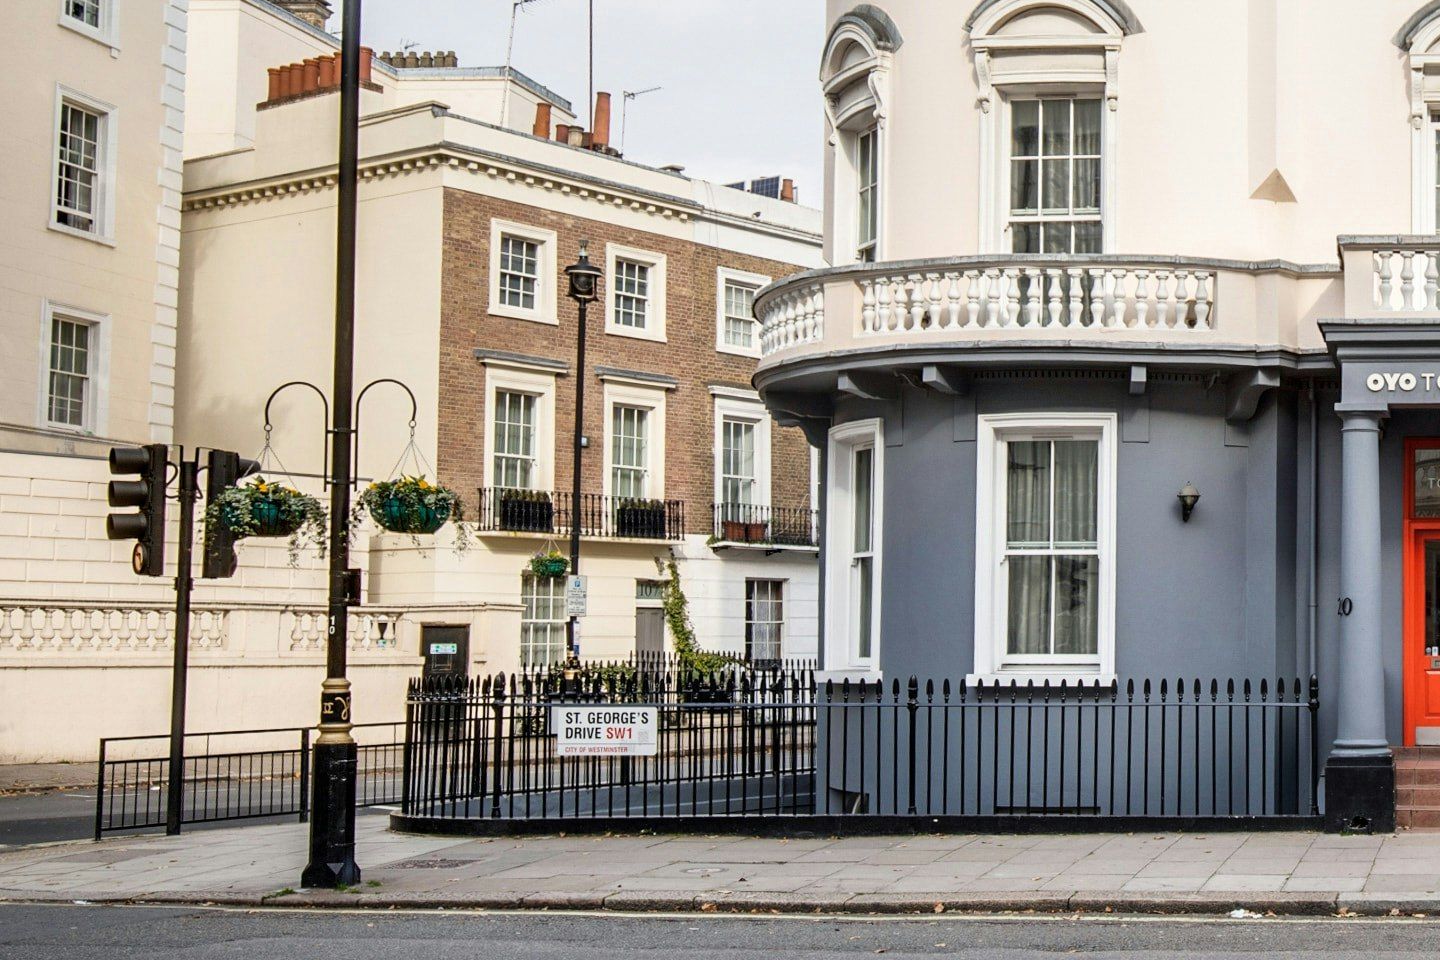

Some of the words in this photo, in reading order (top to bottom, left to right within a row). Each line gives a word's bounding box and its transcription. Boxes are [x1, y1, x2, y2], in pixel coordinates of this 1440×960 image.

[1366, 372, 1417, 392] OYO
[565, 712, 582, 724] ST.
[587, 712, 649, 724] GEORGE'S
[565, 727, 602, 739] DRIVE
[606, 727, 632, 739] SW1
